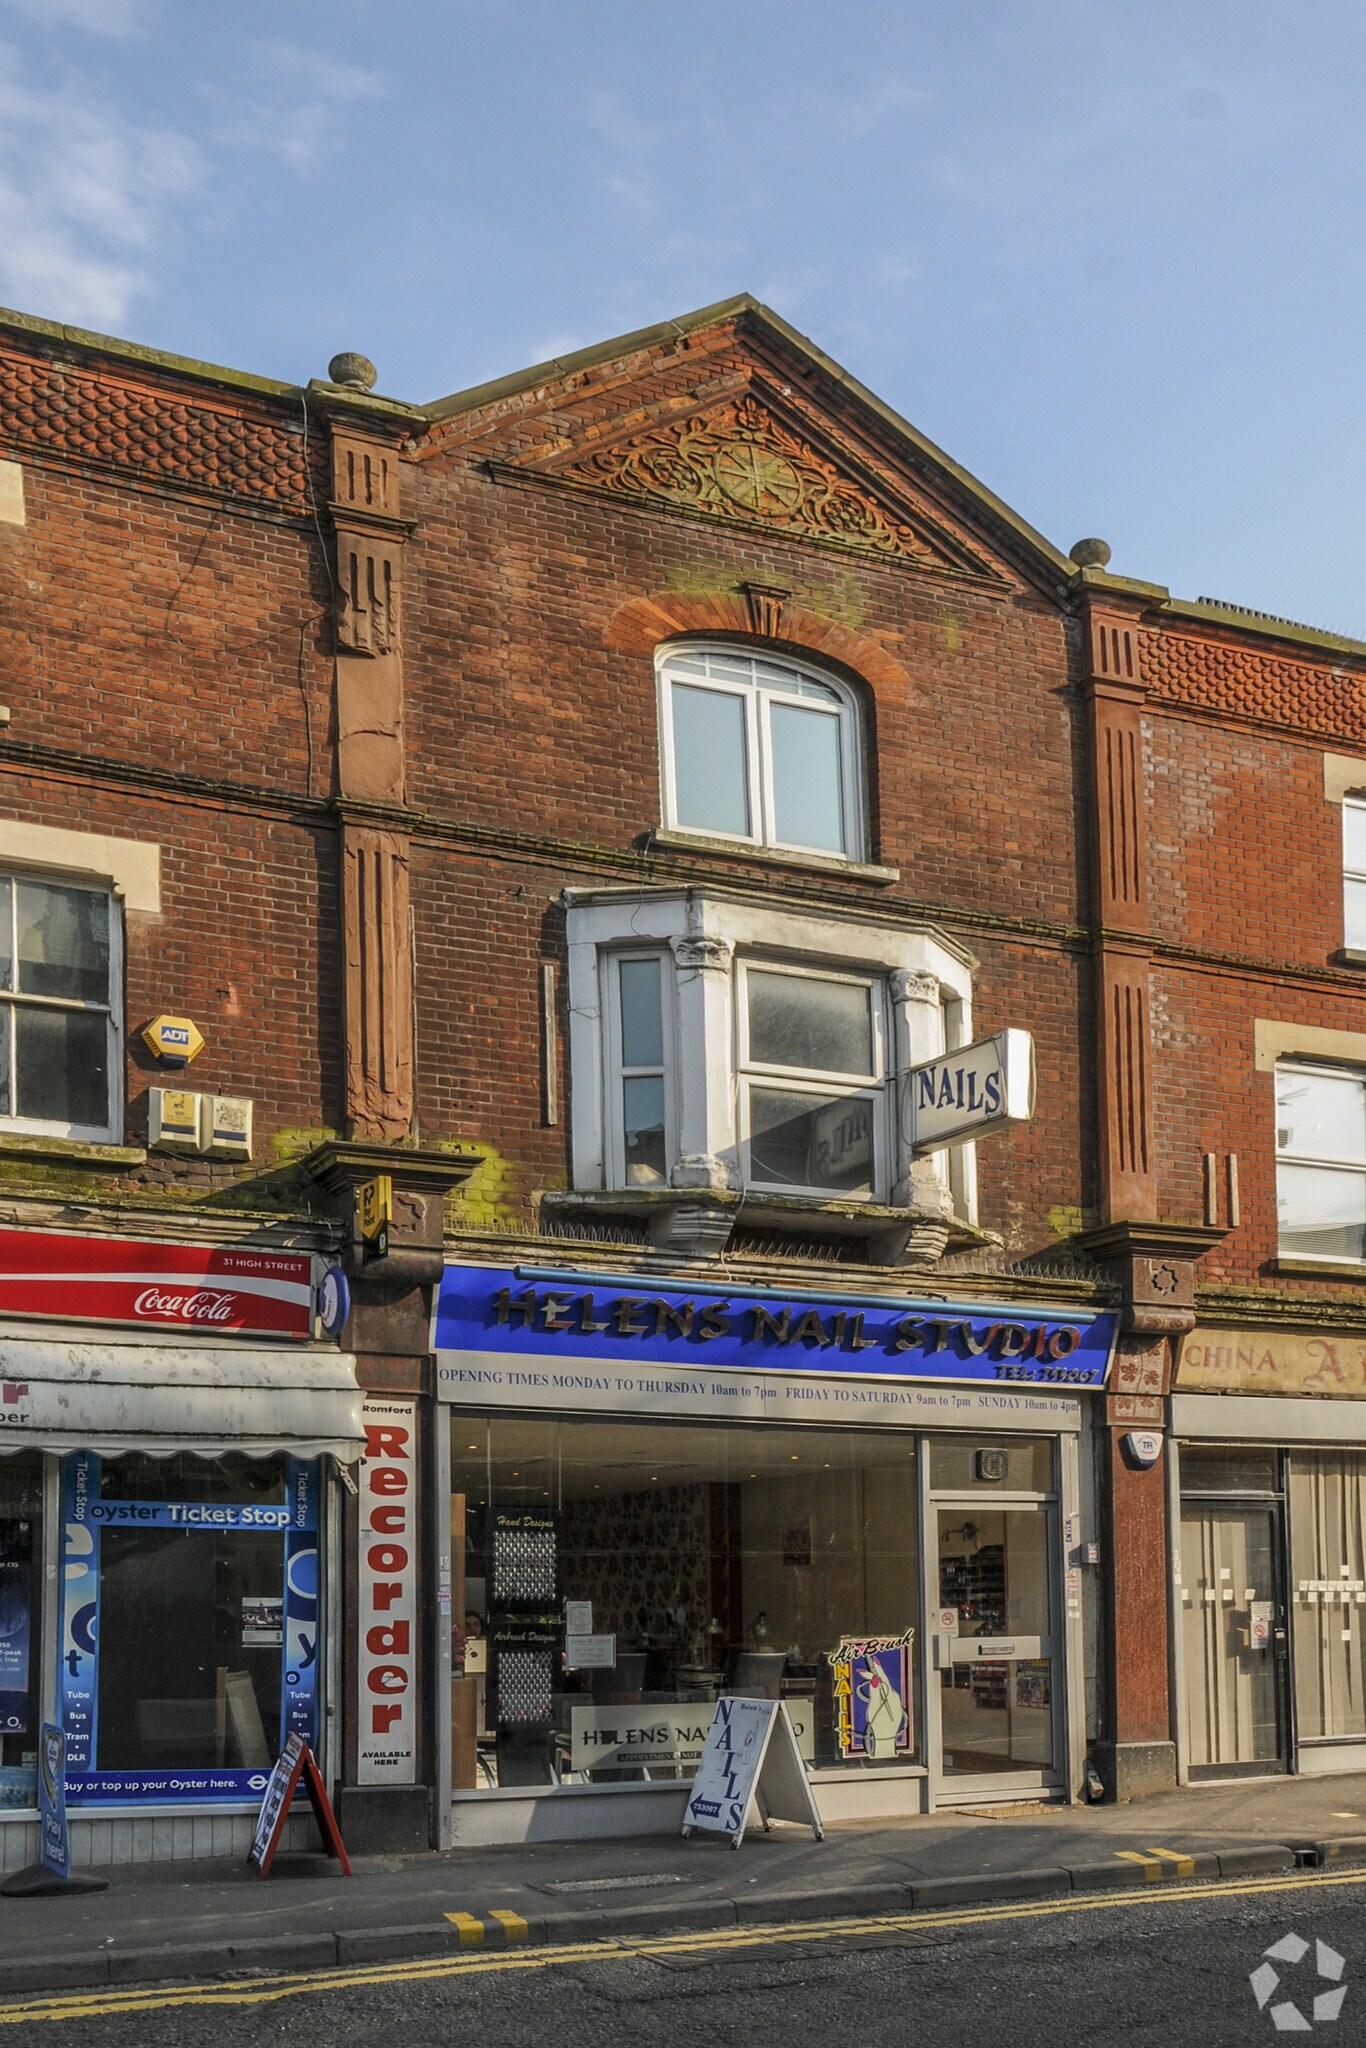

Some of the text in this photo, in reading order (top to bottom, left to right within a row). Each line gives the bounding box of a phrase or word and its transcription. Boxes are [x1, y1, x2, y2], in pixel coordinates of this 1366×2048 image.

[161, 1028, 189, 1043] ADT
[918, 1066, 1001, 1115] NAILS
[223, 1258, 303, 1271] 31 HIGH STREET
[492, 1286, 732, 1339] HELENS
[751, 1304, 878, 1348] NAIL
[1184, 1344, 1279, 1373] CHINA
[438, 1368, 1080, 1414] OPENING TIMES MONDAY TO THURSDAY 10am to 7pm FRIDAY TO SATURDAY 9am to 7pm SUNDAY 10am to 4pm
[362, 1405, 412, 1415] Romford
[1142, 1441, 1153, 1450] TR
[77, 1462, 88, 1495] Ticket
[74, 1496, 87, 1521] Stop
[296, 1472, 308, 1527] Ticket Stop
[91, 1504, 291, 1528] oyster Ticket Stop
[497, 1515, 554, 1529] Hand Designs
[363, 1424, 411, 1733] Recorder
[494, 1631, 556, 1643] Airbrush Designs
[67, 1691, 90, 1699] Tube
[836, 1662, 852, 1747] NAILS
[69, 1712, 87, 1720] Bus
[292, 1711, 308, 1719] Bus
[66, 1733, 90, 1741] Tram
[362, 1751, 412, 1759] AVAILABLE
[712, 1699, 744, 1831] NAILS
[64, 1779, 238, 1793] Buy or top up your Oyster here.
[693, 1802, 718, 1814] 753067
[46, 1812, 62, 1841] Play
[46, 1840, 65, 1864] here!
